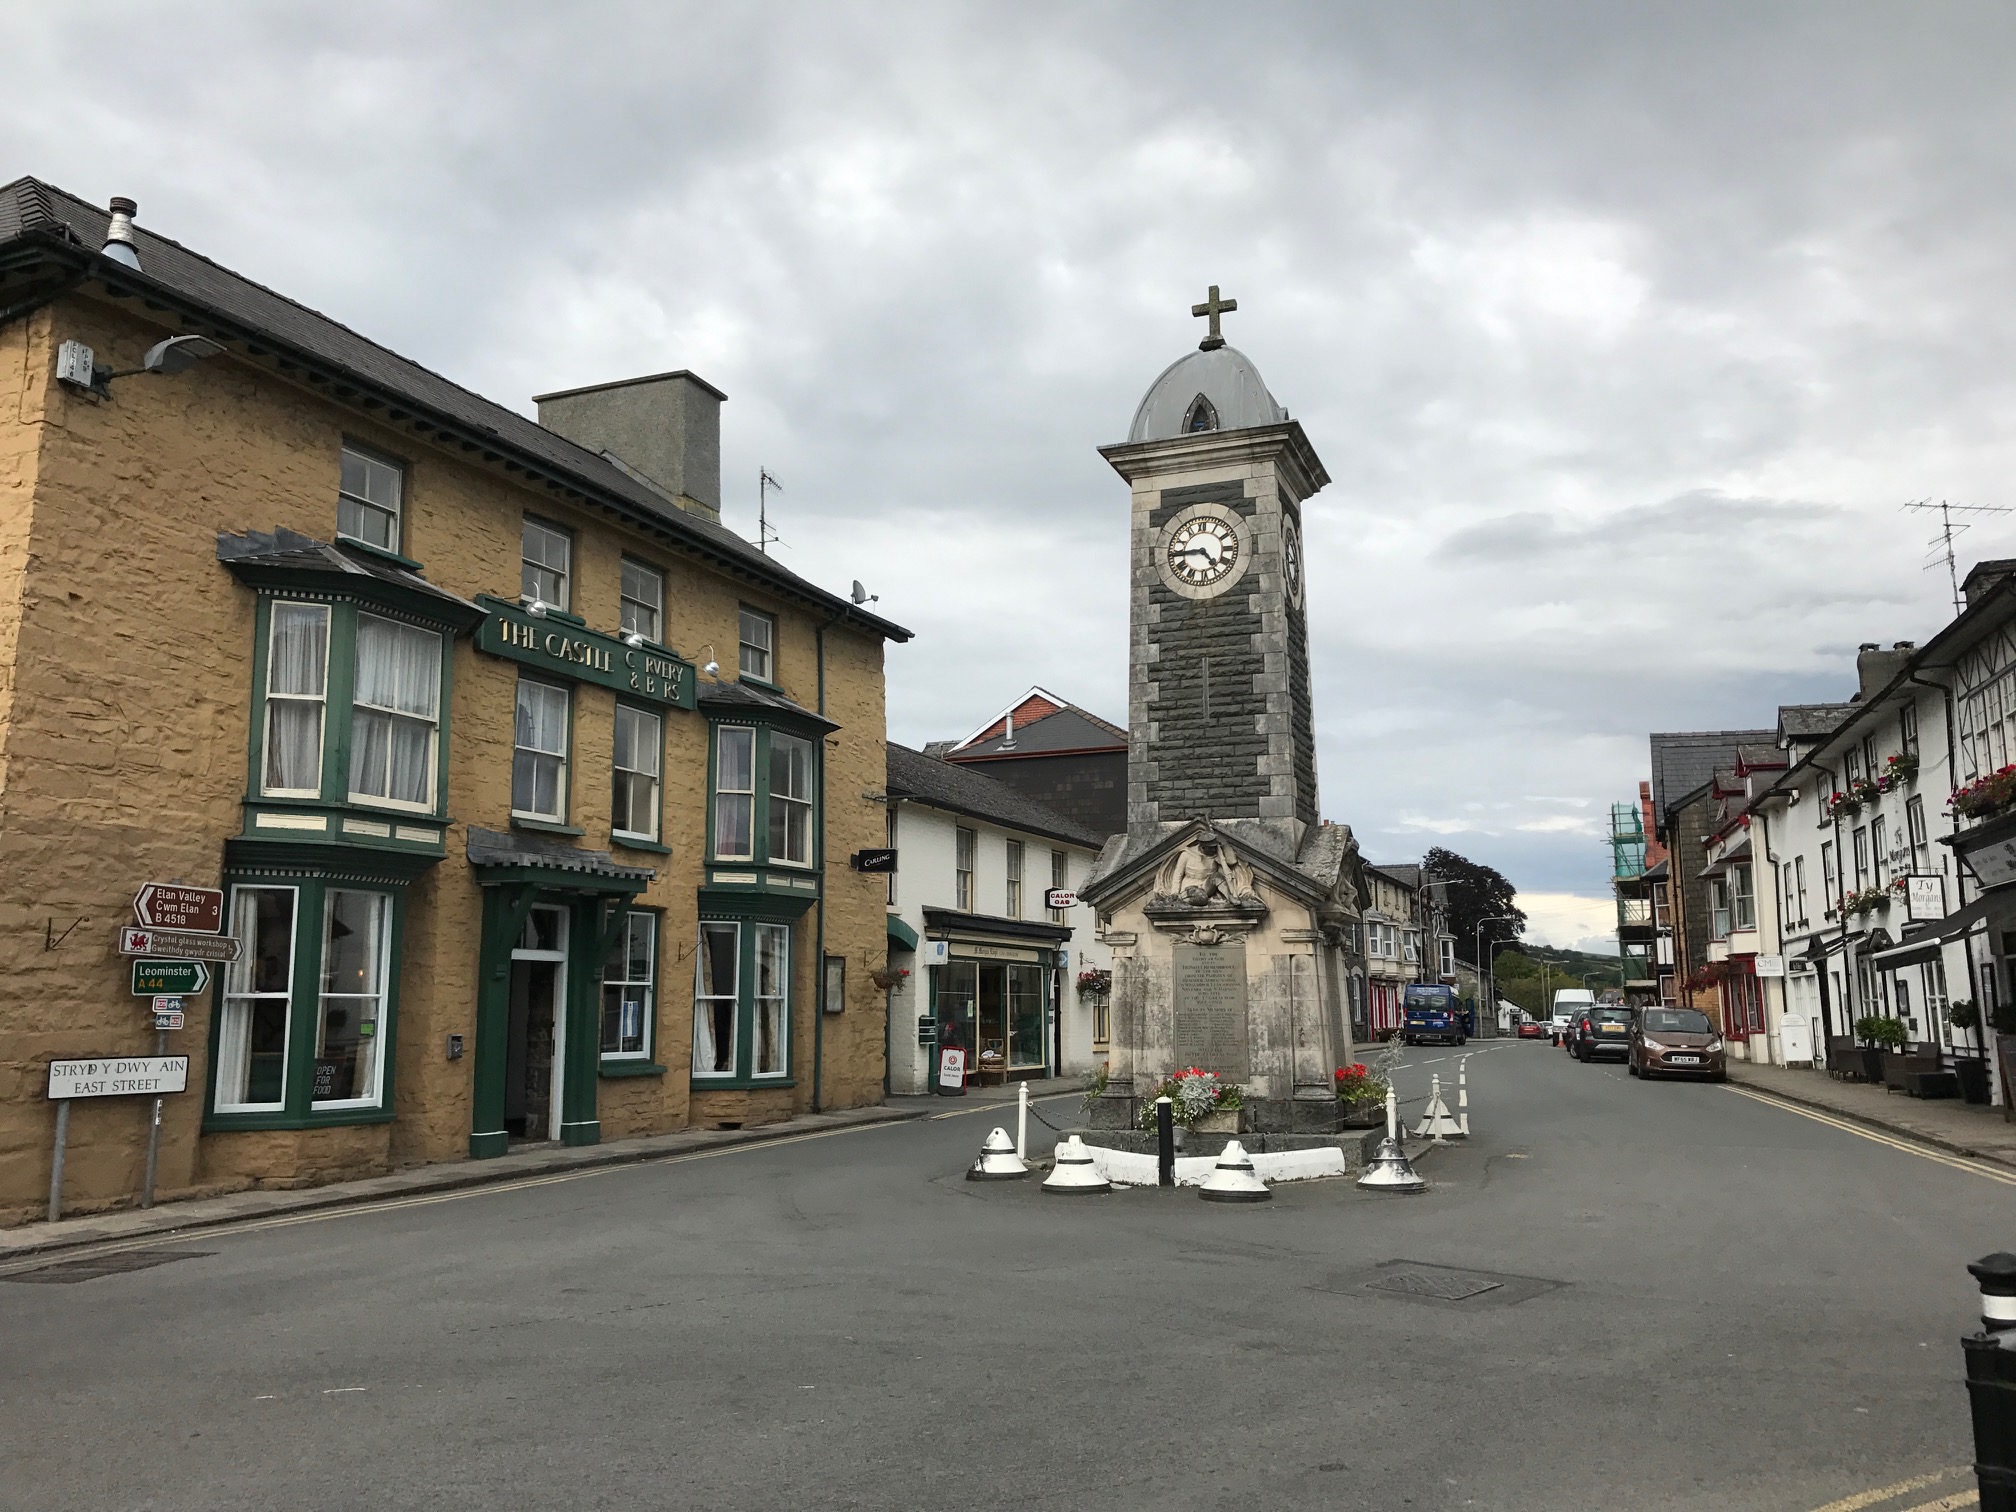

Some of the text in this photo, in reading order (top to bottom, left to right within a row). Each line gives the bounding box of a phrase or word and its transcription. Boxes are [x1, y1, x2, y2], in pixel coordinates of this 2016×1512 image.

[499, 617, 539, 650] THE
[545, 633, 614, 672] CASTLE
[630, 671, 641, 691] &
[157, 888, 206, 904] Elan Valley
[1911, 892, 1941, 906] Morgans
[156, 900, 218, 916] Cwm Elan 3
[155, 912, 186, 925] B 4518
[152, 934, 177, 945] Crystal
[178, 936, 196, 947] glass
[197, 939, 228, 949] workshop
[139, 965, 192, 976] Leominster
[138, 978, 163, 989] A 44
[53, 1063, 98, 1077] STRYD
[102, 1062, 112, 1074] Y
[316, 1065, 337, 1075] OPEN
[74, 1078, 161, 1094] EAST STREET
[316, 1075, 331, 1085] FOR
[312, 1085, 332, 1095] FOOD
